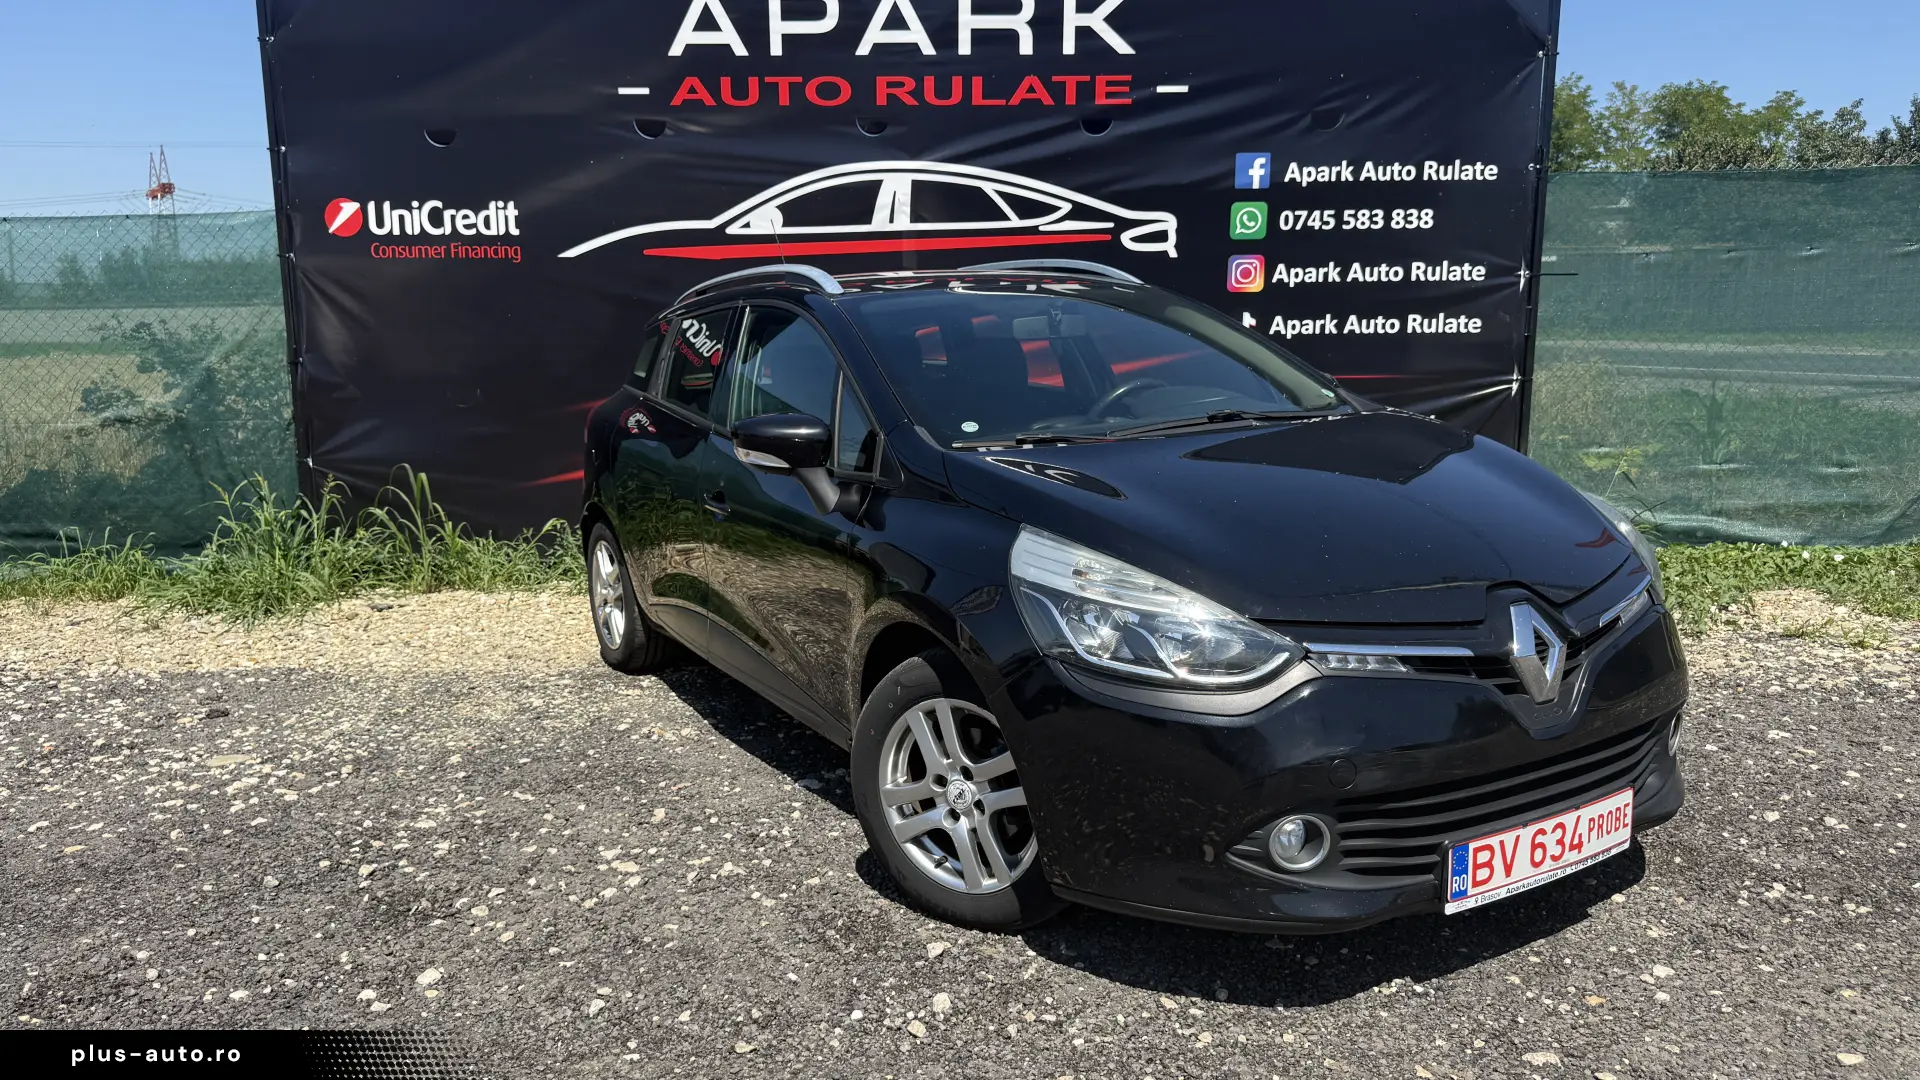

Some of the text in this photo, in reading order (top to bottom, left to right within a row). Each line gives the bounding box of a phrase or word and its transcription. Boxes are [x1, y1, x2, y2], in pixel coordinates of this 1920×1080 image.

[668, 0, 1136, 57] APARK
[671, 75, 1133, 107] AUTO RULATE
[1284, 158, 1499, 187] Apark Auto Rulate
[367, 199, 520, 236] UniCredit
[1279, 208, 1434, 231] 0745 583 838
[370, 241, 522, 264] Consumer Financing
[1271, 260, 1487, 288] Apark Auto Rulate
[1269, 313, 1483, 339] Apark Auto Rulate
[1471, 802, 1630, 889] BV 634 PROBE
[1452, 874, 1468, 893] RO
